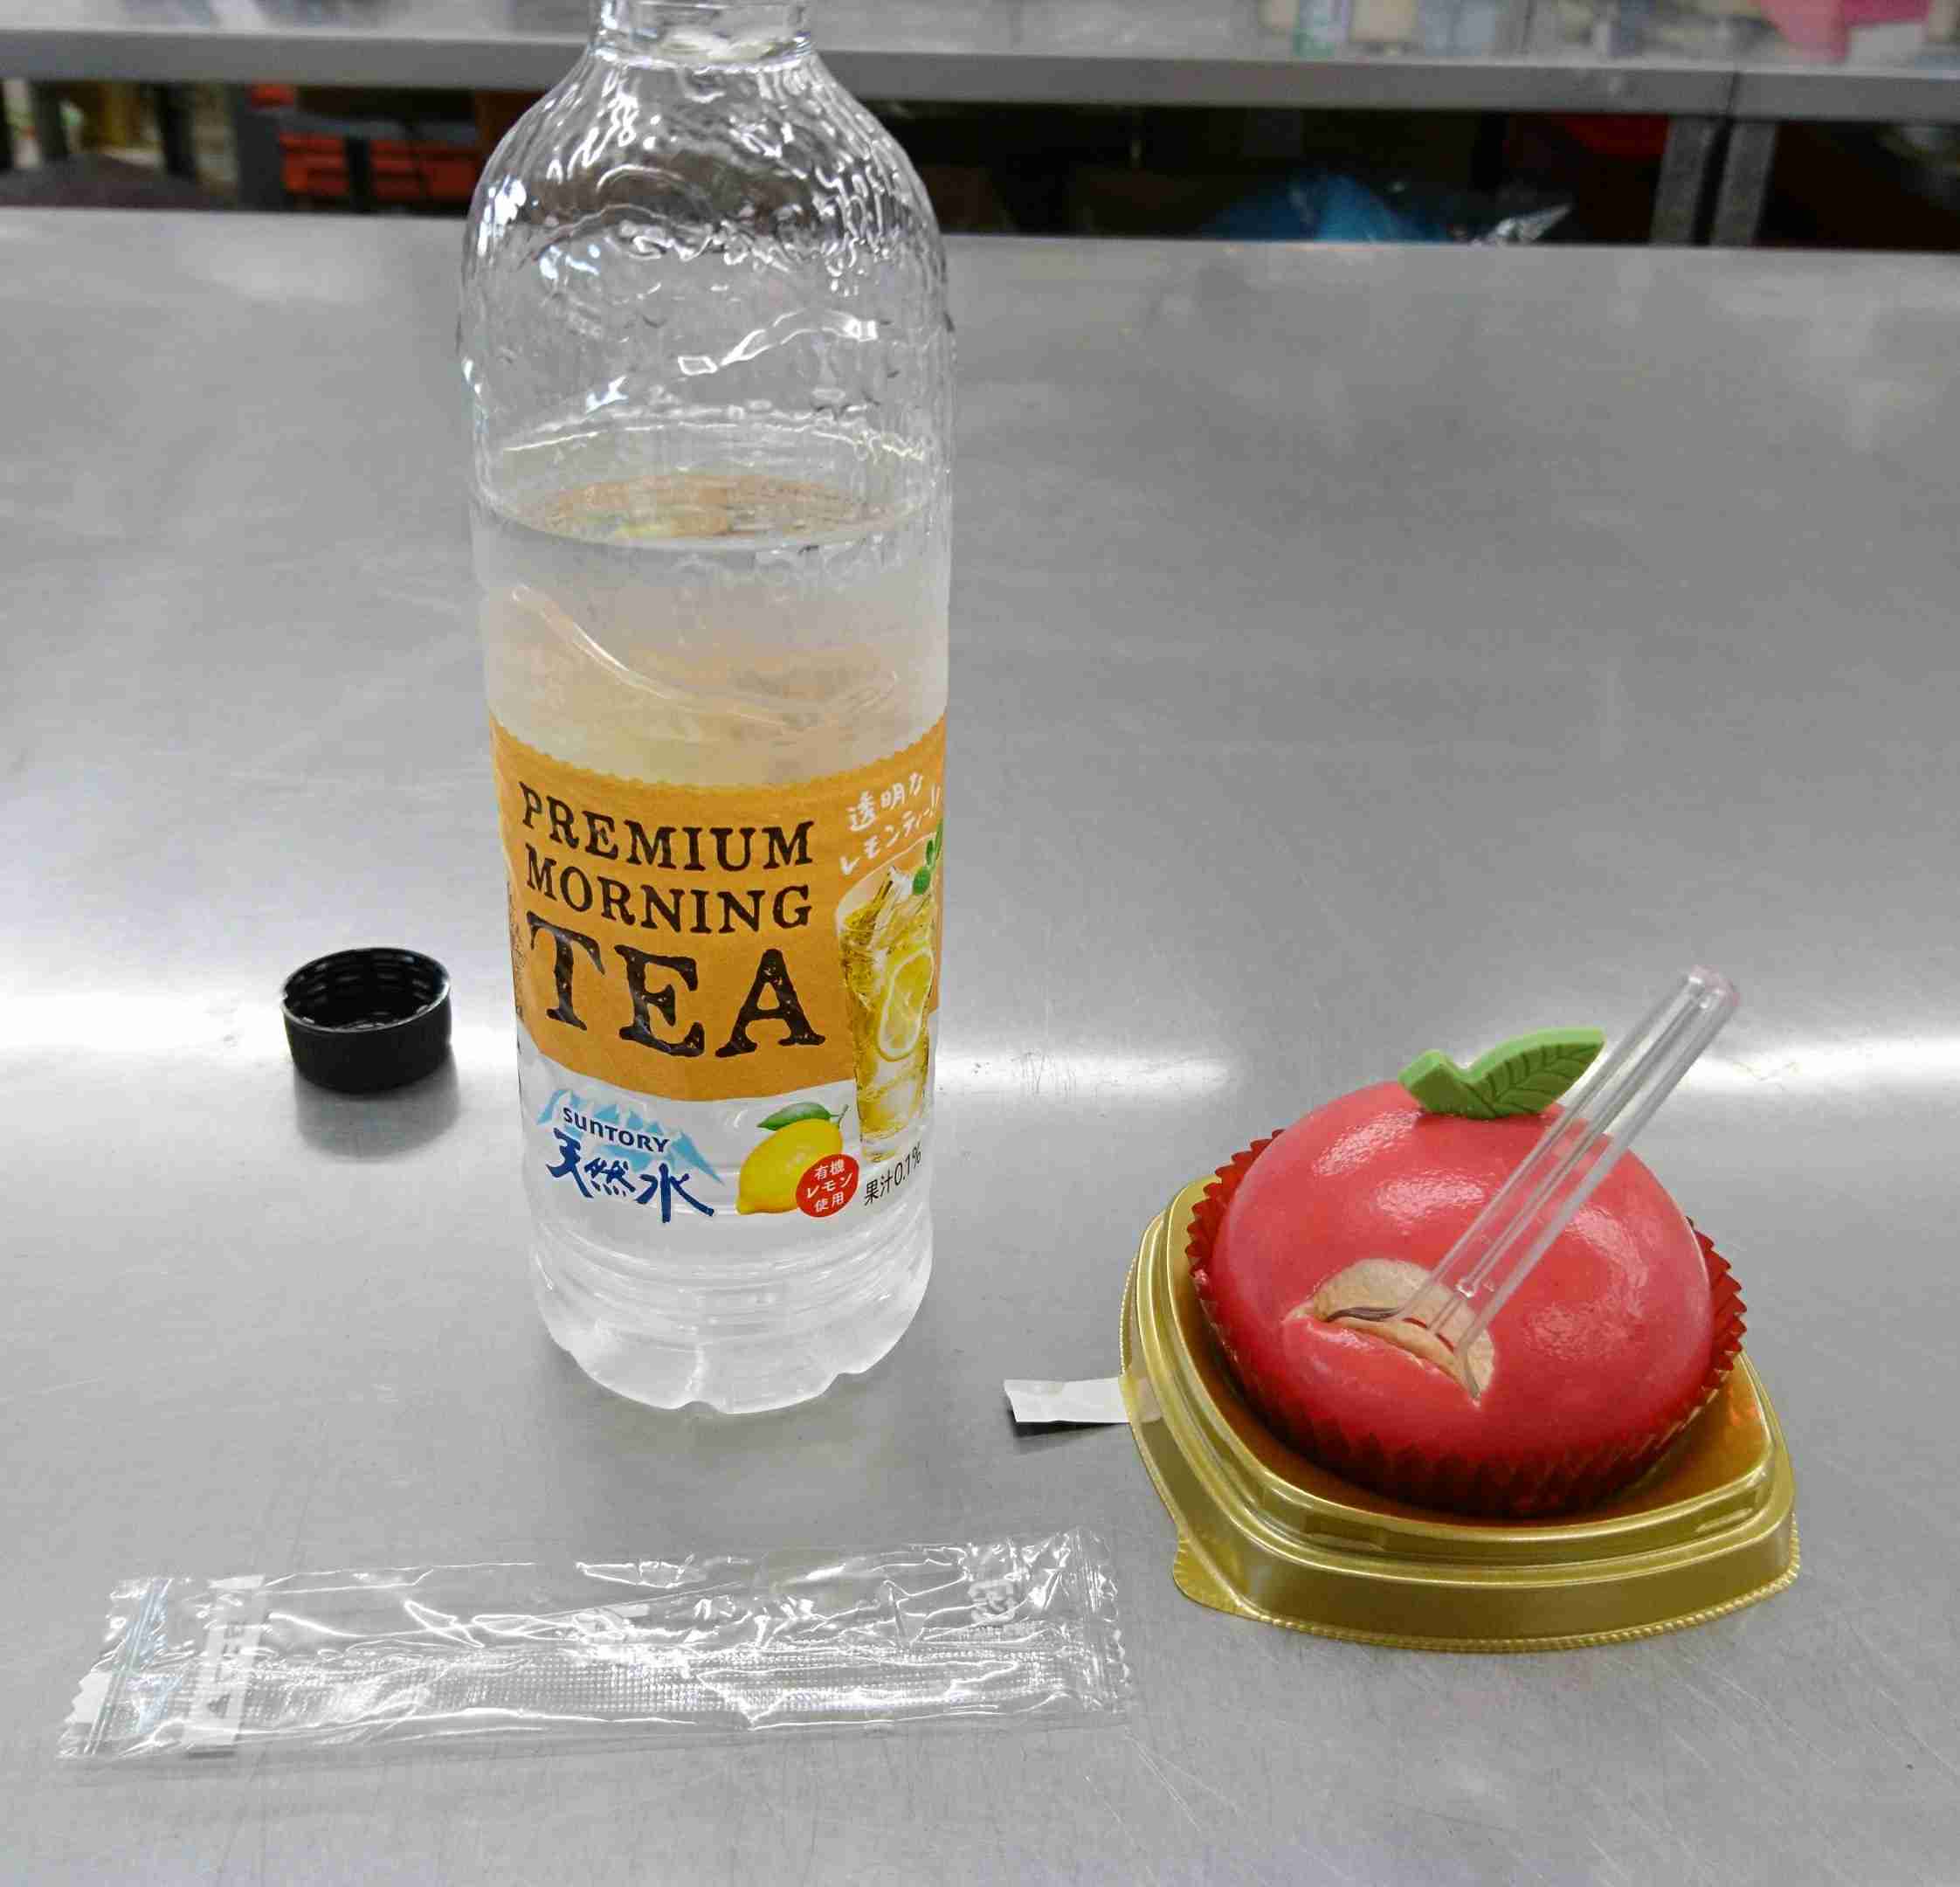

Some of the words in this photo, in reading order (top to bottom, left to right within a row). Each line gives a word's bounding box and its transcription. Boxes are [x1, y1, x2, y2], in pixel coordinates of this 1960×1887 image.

[519, 781, 815, 872] PREMIUM
[525, 842, 812, 934] MORNING
[527, 910, 825, 1058] TEA
[562, 1107, 670, 1153] SUNTORY
[546, 1127, 714, 1224] 天然水
[806, 1172, 852, 1199] レモン
[814, 1158, 845, 1180] 有機
[864, 1141, 922, 1206] 果汁0.1%
[814, 1192, 845, 1213] 使用
